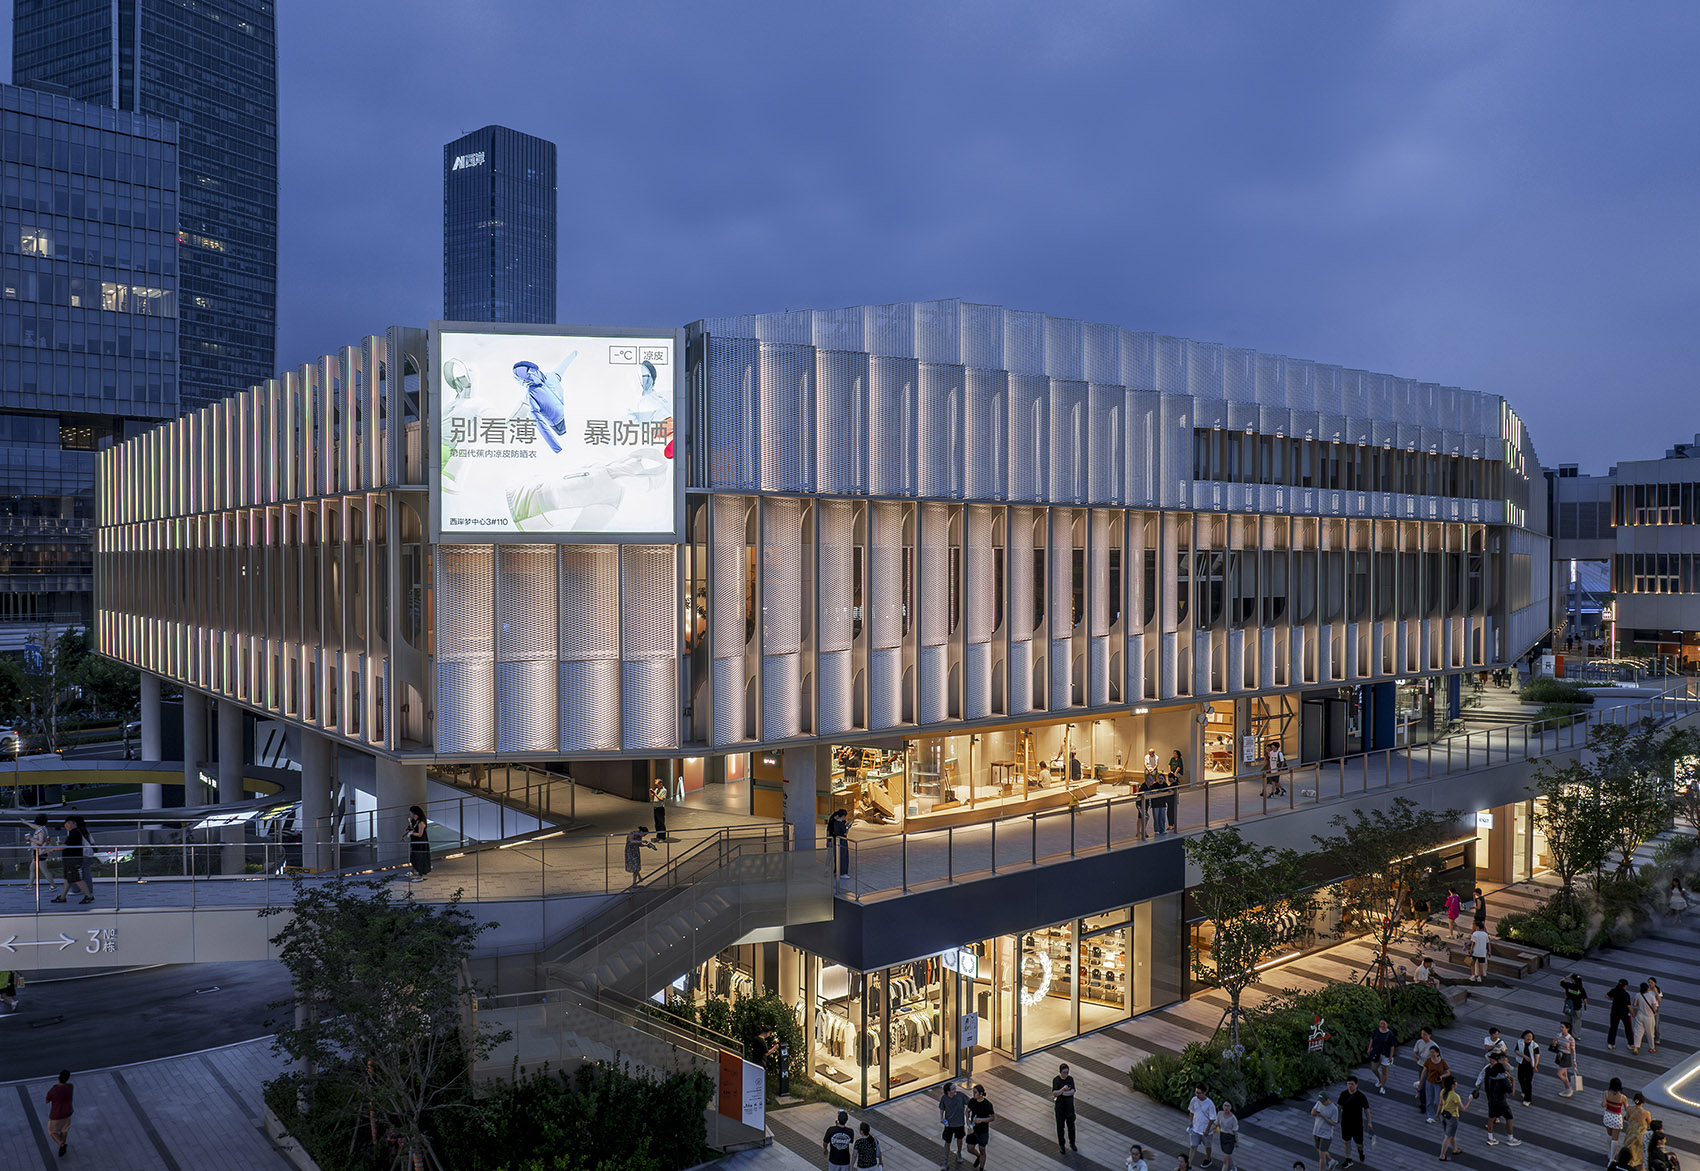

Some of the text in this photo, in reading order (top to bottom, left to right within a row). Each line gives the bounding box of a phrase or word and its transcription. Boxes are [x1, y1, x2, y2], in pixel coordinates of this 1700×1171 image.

[643, 351, 663, 361] 凉皮
[450, 416, 668, 446] 别看薄 暴防晒
[86, 930, 100, 953] 3
